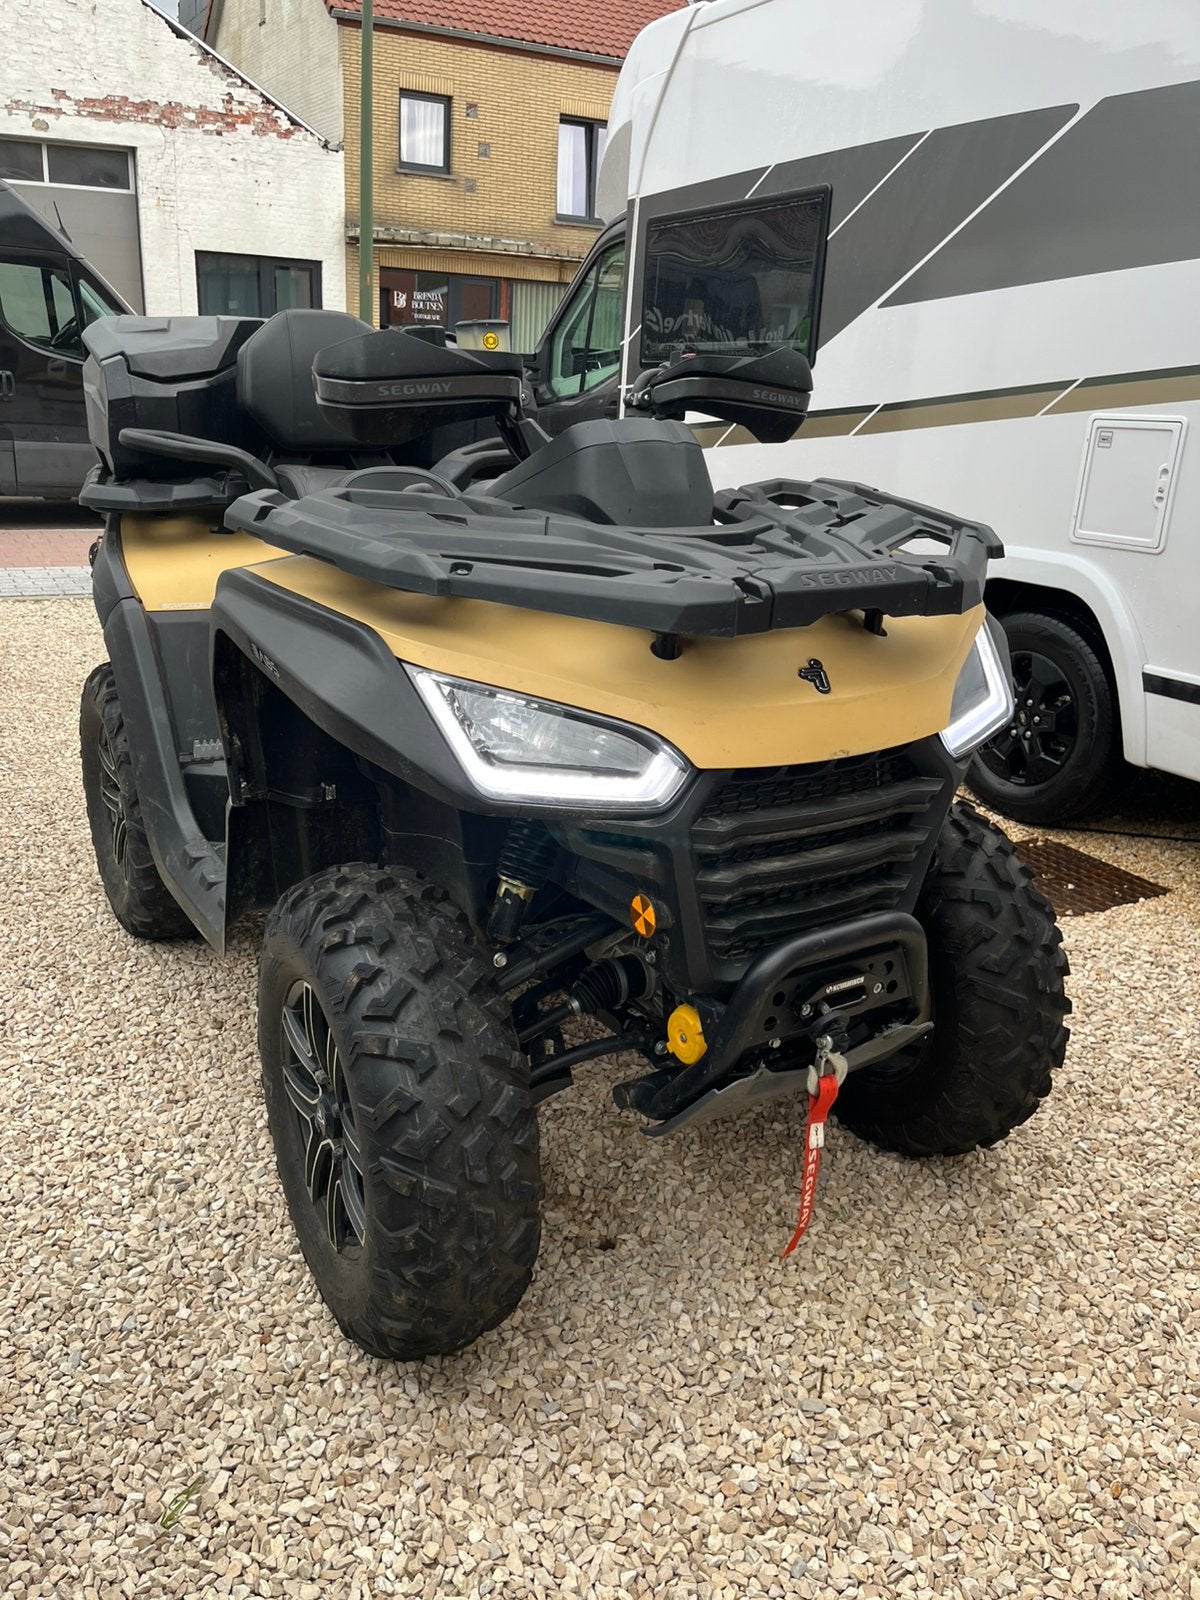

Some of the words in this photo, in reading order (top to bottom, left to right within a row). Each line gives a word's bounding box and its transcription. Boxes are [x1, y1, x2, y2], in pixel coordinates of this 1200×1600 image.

[411, 300, 444, 311] BOUTSEN
[413, 291, 444, 305] BRENDA
[378, 382, 452, 396] SEGWAY
[752, 389, 801, 405] SEGWAY
[800, 567, 897, 588] SEGWAY
[799, 1149, 818, 1228] SEGWAY
